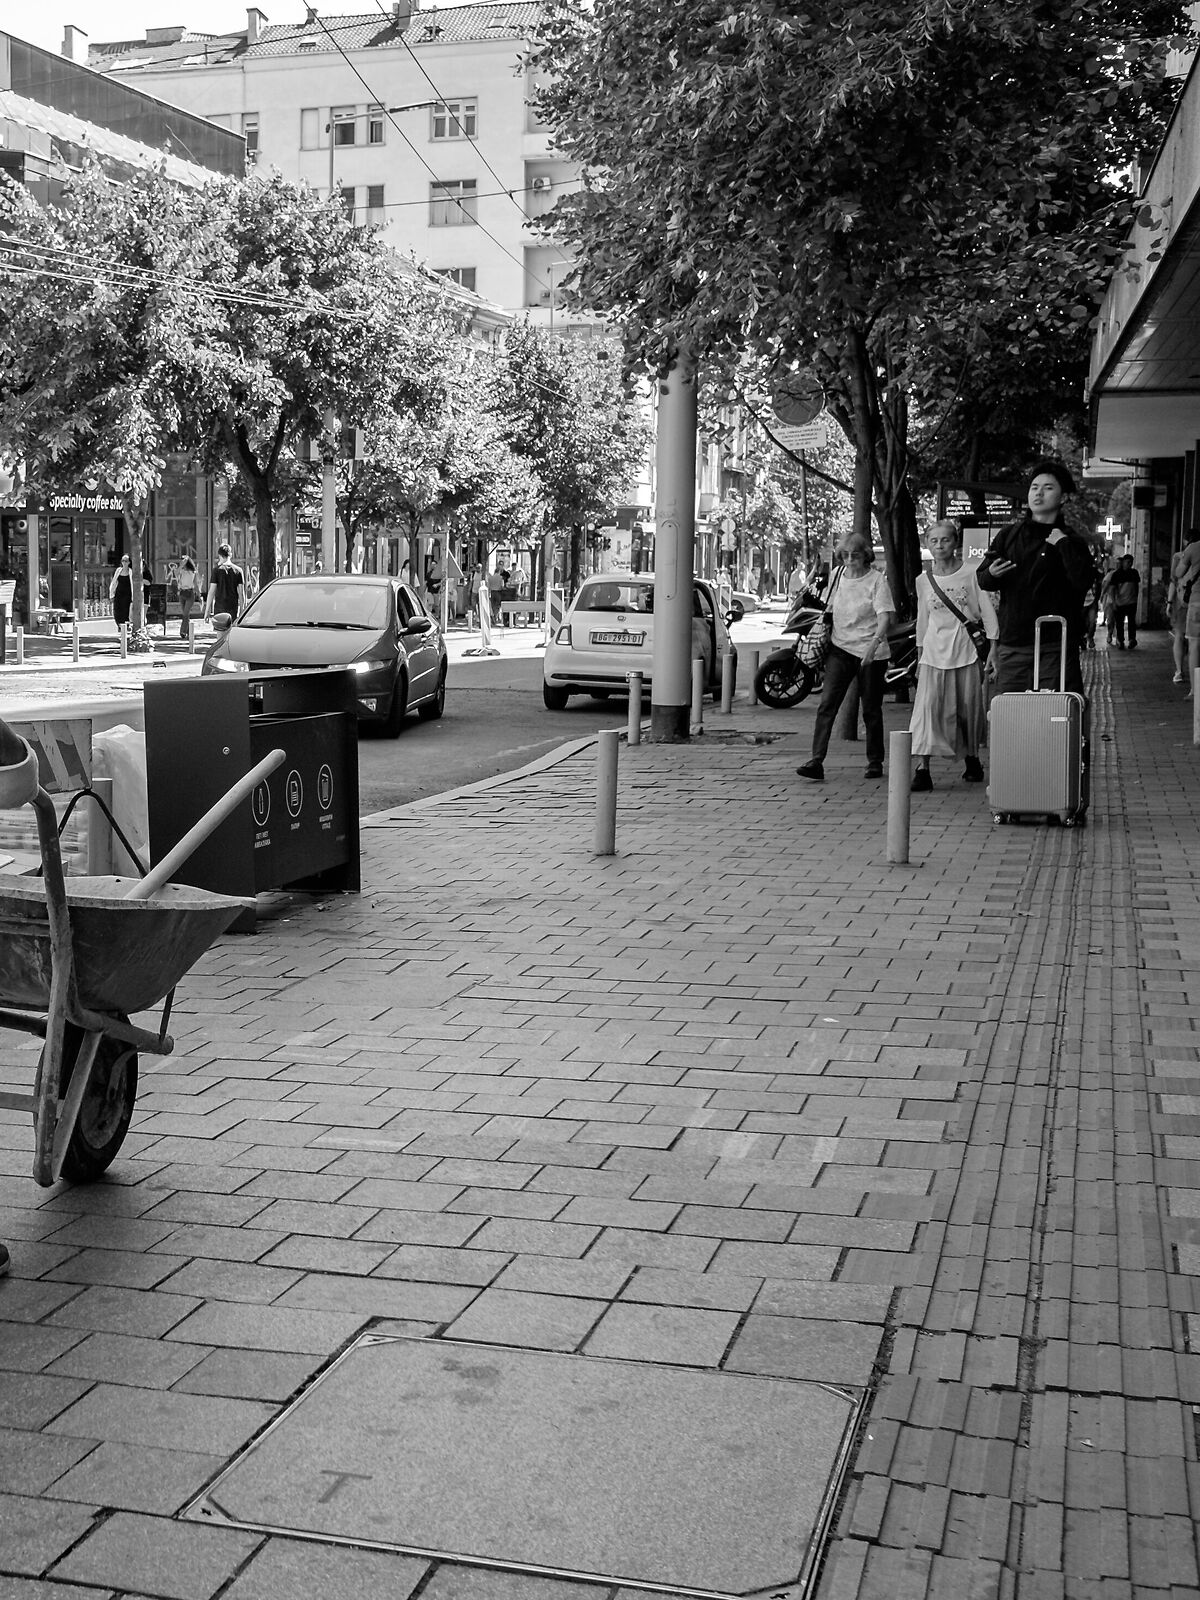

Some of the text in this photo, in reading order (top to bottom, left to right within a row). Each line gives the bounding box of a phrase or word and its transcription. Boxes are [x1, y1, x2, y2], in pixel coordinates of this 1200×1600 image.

[49, 491, 86, 513] Specialty
[86, 494, 110, 513] coffee
[968, 546, 988, 559] jog
